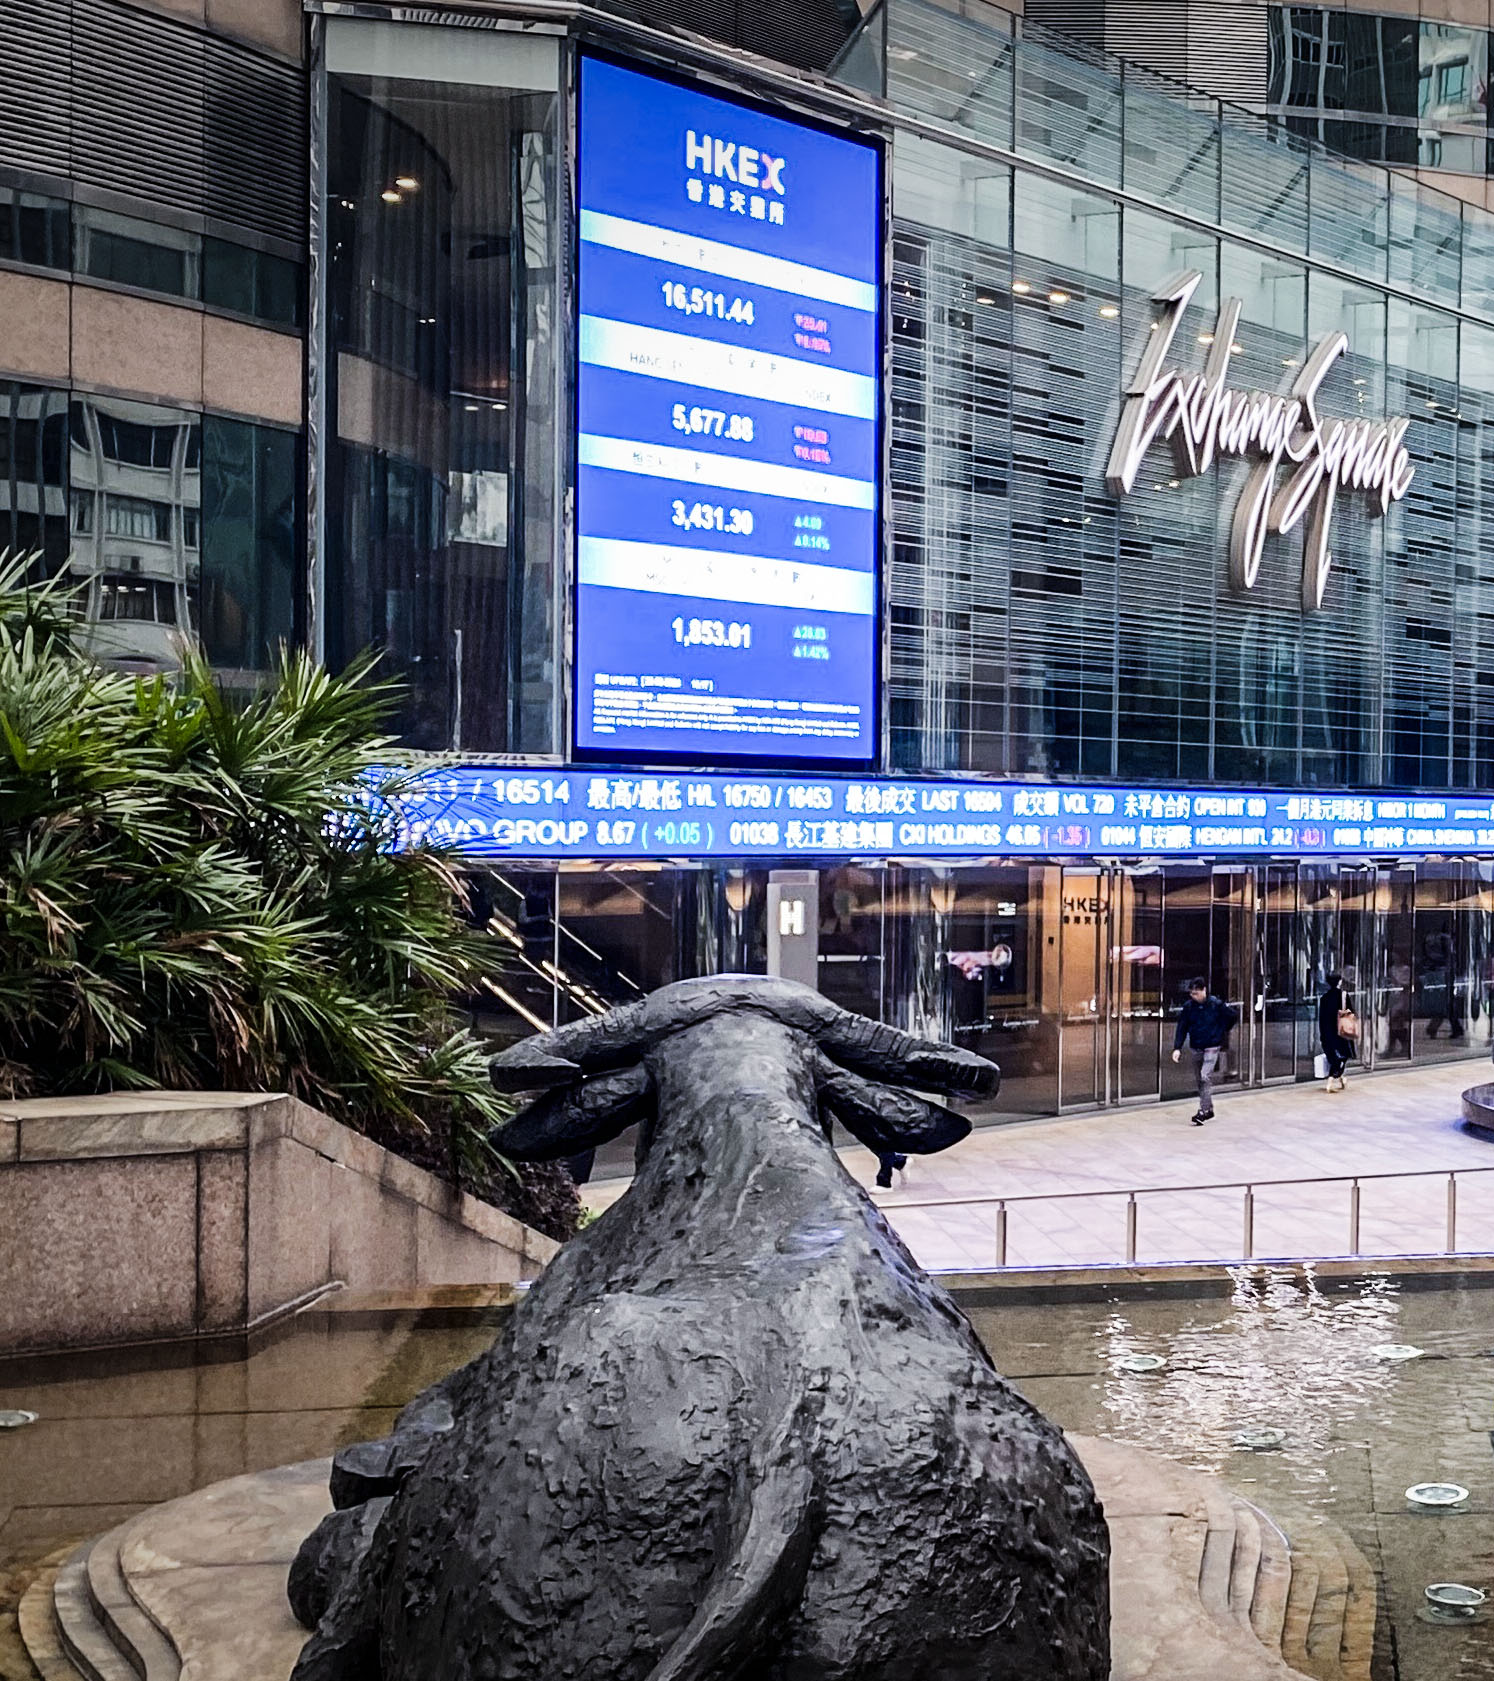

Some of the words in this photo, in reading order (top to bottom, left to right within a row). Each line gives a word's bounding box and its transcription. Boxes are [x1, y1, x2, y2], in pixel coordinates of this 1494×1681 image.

[686, 130, 785, 196] HKEX
[662, 281, 755, 325] 16,511.44
[673, 404, 753, 441] 5,677.88
[672, 500, 753, 534] 3,431.30
[672, 616, 750, 649] 1,853.01
[493, 779, 569, 803] 16514
[587, 779, 681, 810] 最高/最低
[723, 784, 771, 807] 16750
[787, 786, 832, 809] 16453
[846, 783, 916, 814] 最後成交
[922, 790, 960, 811] LAST
[1063, 794, 1089, 813] VOL
[492, 819, 588, 845] GROUP
[597, 821, 635, 845] 8.67
[779, 900, 804, 935] H
